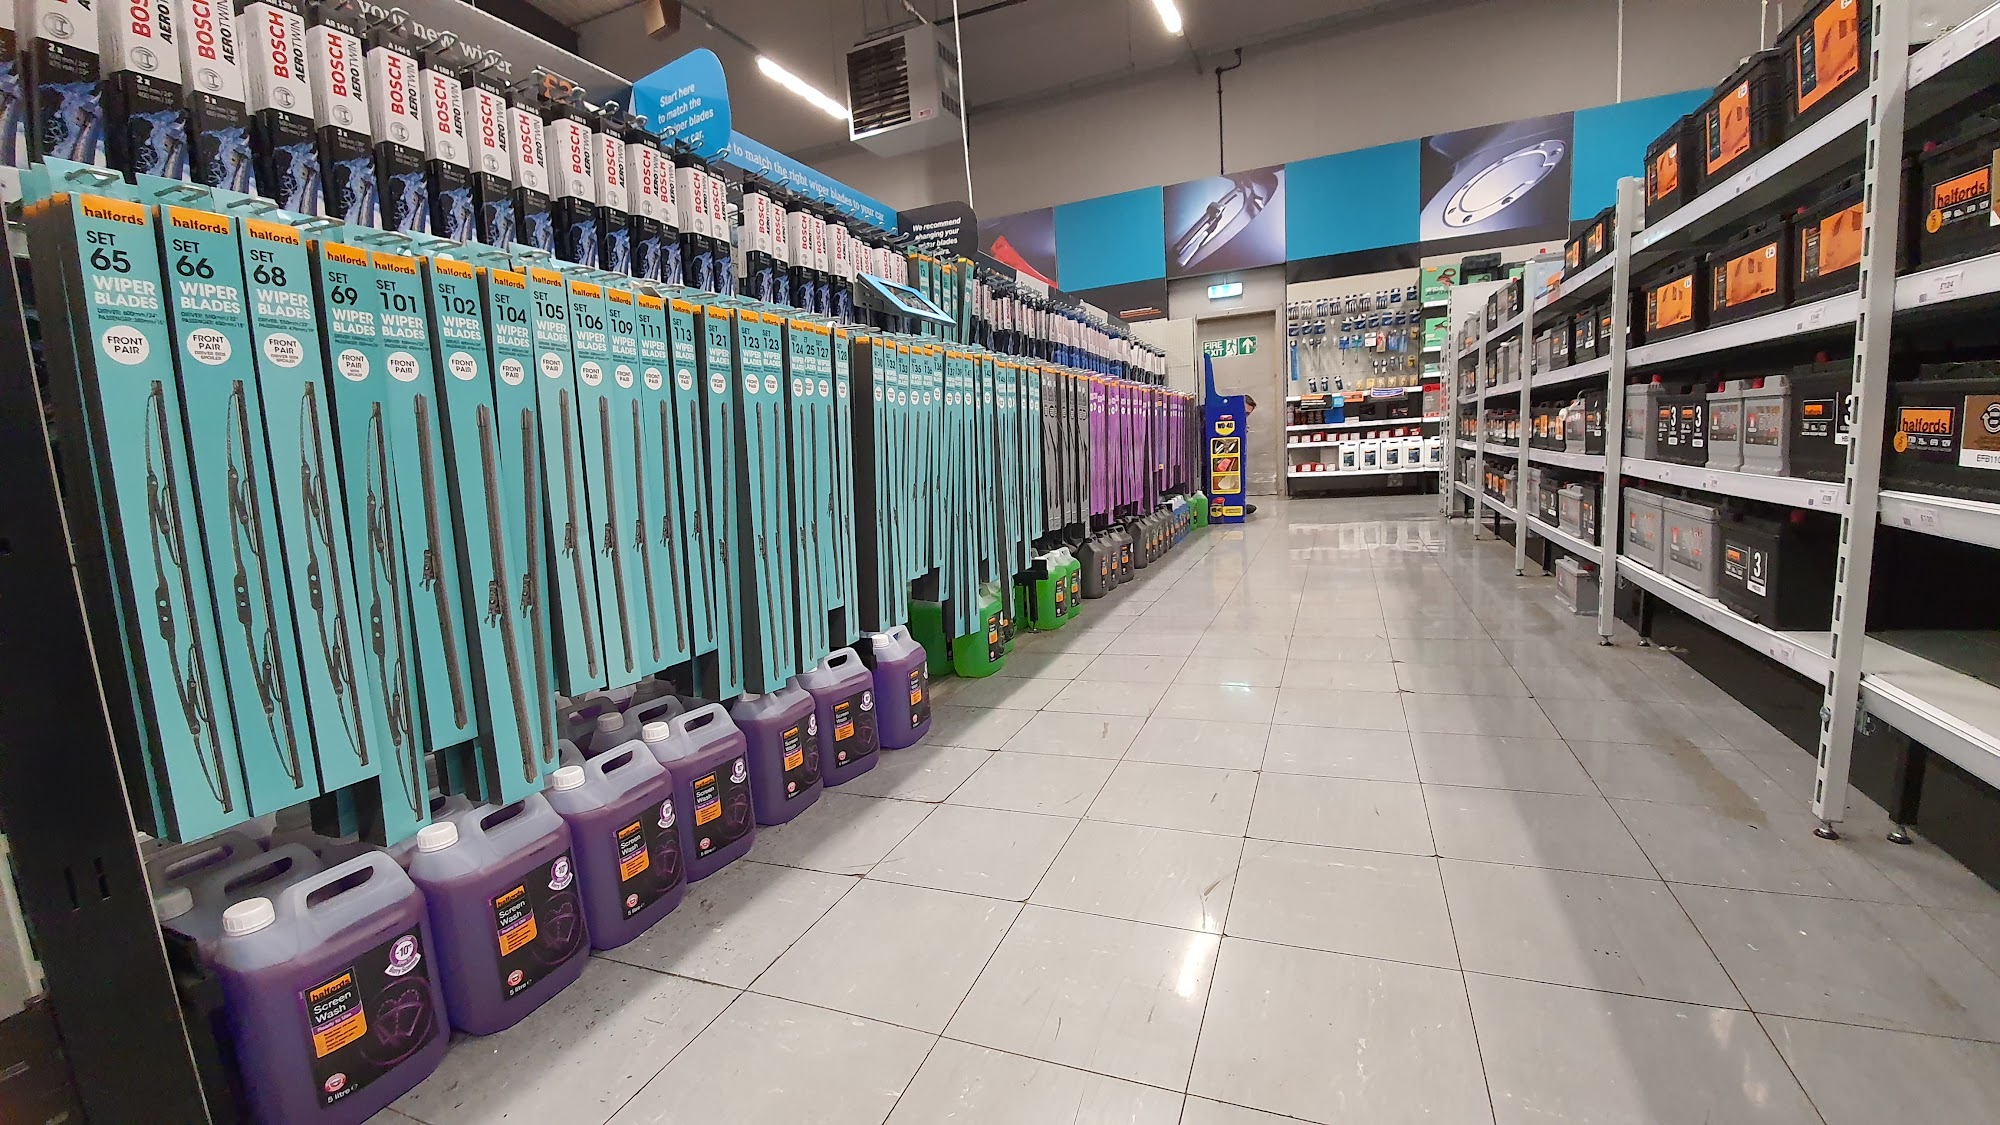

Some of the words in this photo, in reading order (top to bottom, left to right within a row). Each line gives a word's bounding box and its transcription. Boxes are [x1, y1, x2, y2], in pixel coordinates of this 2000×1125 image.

[268, 11, 290, 79] BOSCH
[290, 18, 306, 84] AEROTWIN
[412, 22, 454, 48] new
[459, 42, 512, 75] wiper
[327, 33, 348, 97] BOSCH
[349, 40, 363, 102] AEROTWIN
[388, 54, 405, 116] BOSCH
[406, 62, 419, 120] AEROTWIN
[660, 90, 678, 107] Start
[678, 84, 695, 98] here
[434, 76, 451, 134] BOSCH
[451, 82, 464, 138] AEROTWIN
[658, 114, 666, 124] to
[666, 103, 688, 120] match
[689, 98, 702, 110] the
[480, 94, 496, 148] BOSCH
[689, 108, 714, 126] blades
[496, 100, 507, 152] AEROTWIN
[519, 114, 534, 164] BOSCH
[534, 119, 544, 168] AEROTWIN
[690, 130, 704, 144] car.
[570, 125, 582, 174] BOSCH
[582, 130, 592, 177] AEROTWIN
[606, 139, 616, 186] BOSCH
[616, 142, 626, 188] AEROTWIN
[660, 162, 668, 204] BOSCH
[734, 144, 743, 156] to
[745, 150, 773, 170] match
[774, 161, 788, 178] the
[790, 170, 809, 187] right
[808, 180, 830, 196] wiper
[830, 187, 853, 207] blades
[852, 198, 860, 208] to
[860, 204, 875, 218] your
[874, 208, 886, 222] car
[694, 172, 702, 214] BOSCH
[710, 181, 720, 220] BOSCH
[1937, 181, 1985, 208] halfords
[84, 206, 144, 226] halfords
[912, 224, 922, 232] We
[924, 216, 962, 230] recommend
[172, 216, 228, 235] halfords
[944, 228, 960, 238] your
[86, 230, 116, 246] SET
[250, 228, 299, 246] halfords
[936, 238, 958, 246] blades
[172, 239, 200, 254] SET
[90, 248, 132, 274] 65
[250, 250, 274, 264] SET
[327, 252, 367, 267] halfords
[176, 256, 214, 279] 66
[253, 265, 287, 286] 68
[374, 260, 416, 275] halfords
[436, 266, 472, 280] halfords
[92, 274, 156, 296] WIPER
[328, 272, 348, 284] SET
[376, 280, 396, 292] SET
[494, 277, 524, 290] halfords
[533, 275, 562, 287] halfords
[178, 280, 238, 300] WIPER
[331, 286, 358, 306] 69
[438, 284, 456, 294] SET
[534, 291, 548, 300] SET
[572, 288, 600, 298] halfords
[94, 292, 158, 310] BLADES
[180, 296, 240, 314] BLADES
[256, 288, 309, 308] WIPER
[380, 292, 416, 313] 101
[442, 295, 476, 316] 102
[494, 293, 510, 304] SET
[608, 294, 632, 306] halfords
[258, 304, 311, 320] BLADES
[496, 304, 526, 324] 104
[536, 302, 564, 320] 105
[574, 303, 588, 312] SET
[610, 309, 620, 318] SET
[332, 308, 374, 324] WIPER
[380, 314, 424, 328] WIPER
[442, 315, 480, 330] WIPER
[576, 313, 603, 330] 106
[640, 314, 650, 322] SET
[334, 322, 376, 336] BLADES
[382, 326, 426, 340] BLADES
[444, 327, 481, 340] BLADES
[496, 324, 528, 338] WIPER
[536, 320, 566, 334] WIPER
[611, 318, 632, 335] 109
[641, 324, 661, 339] 111
[674, 327, 692, 342] 113
[107, 336, 144, 346] FRONT
[192, 334, 224, 344] FRONT
[269, 338, 297, 348] FRONT
[496, 336, 530, 348] BLADES
[538, 331, 568, 343] BLADES
[576, 330, 606, 342] WIPER
[612, 335, 636, 347] WIPER
[710, 332, 726, 348] 121
[742, 336, 760, 348] 123
[764, 337, 780, 350] 123
[114, 346, 140, 354] PAIR
[198, 342, 220, 350] PAIR
[577, 341, 606, 352] BLADES
[612, 346, 636, 356] BLADES
[642, 340, 665, 350] WIPER
[675, 342, 694, 352] WIPER
[709, 348, 730, 357] WIPER
[792, 342, 804, 355] 124
[817, 347, 829, 358] 127
[1204, 341, 1223, 350] FIRE
[642, 350, 666, 358] BLADES
[837, 350, 847, 360] 128
[1671, 406, 1677, 426] 3
[1695, 406, 1702, 427] 3
[1902, 418, 1947, 432] halfords
[1754, 552, 1762, 578] 3
[696, 786, 715, 798] Screen
[696, 794, 712, 804] Wash
[620, 834, 641, 850] Screen
[621, 844, 638, 856] Wash
[499, 900, 526, 918] Screen
[500, 911, 522, 927] Wash
[314, 991, 352, 1014] Screen
[315, 1004, 346, 1024] Wash
[335, 1088, 350, 1100] litre
